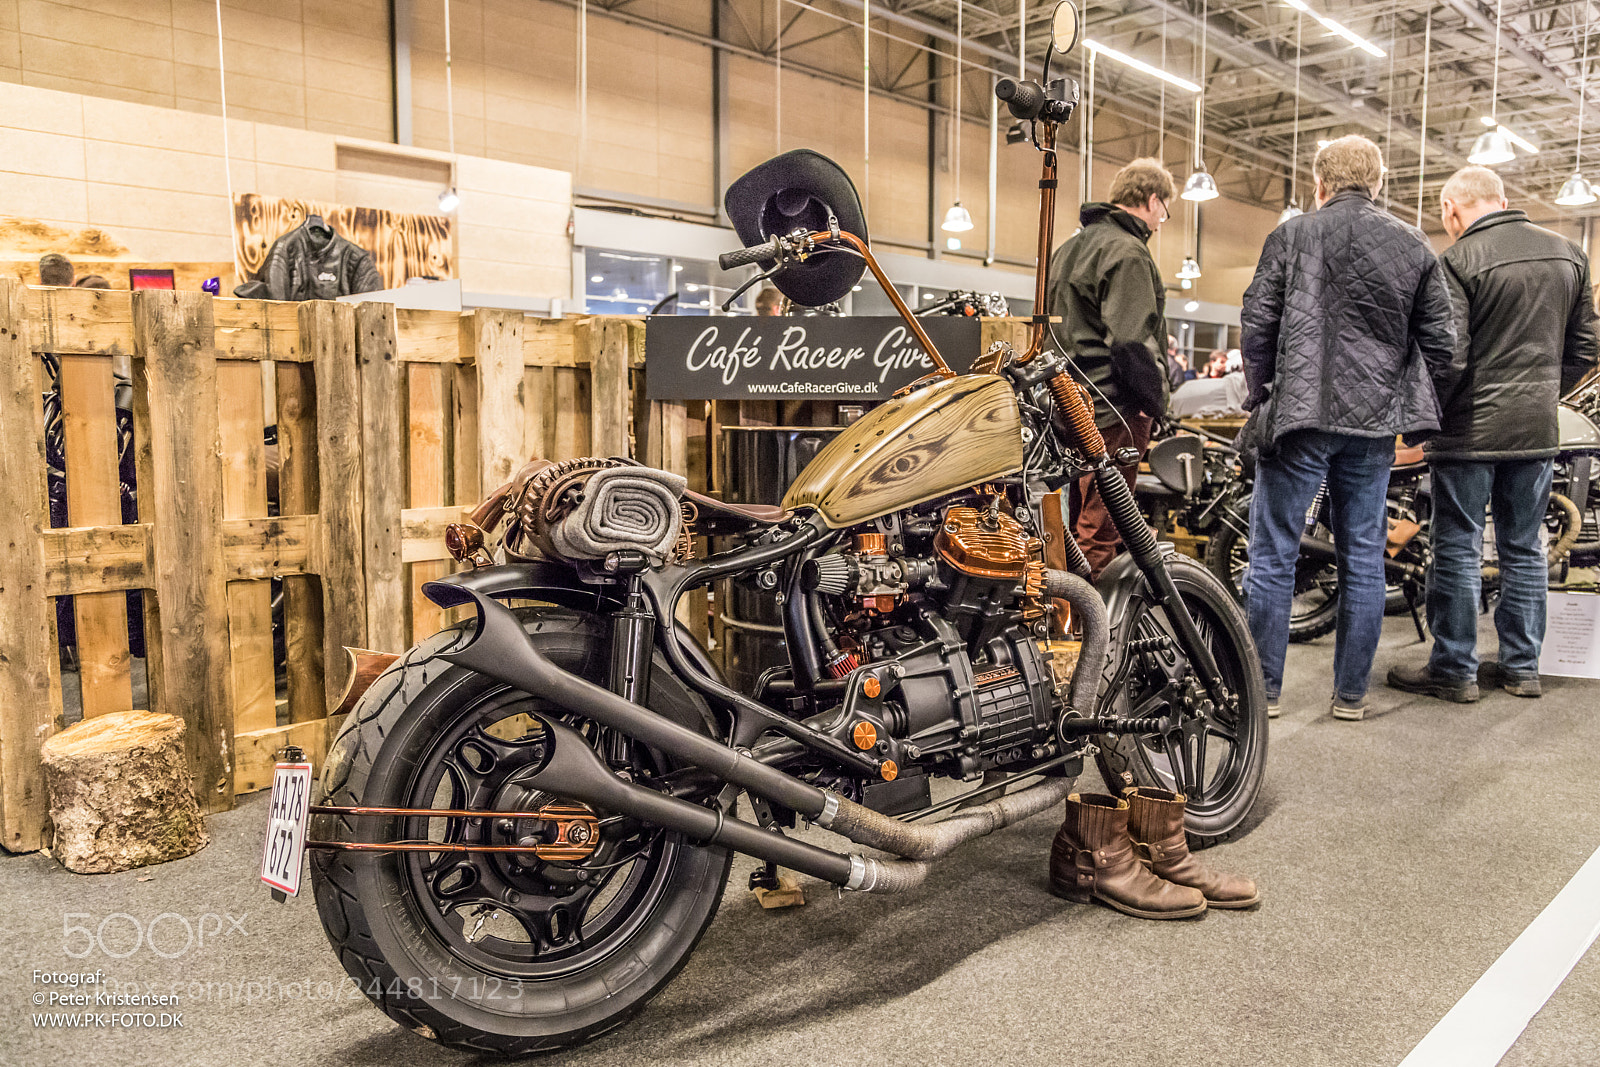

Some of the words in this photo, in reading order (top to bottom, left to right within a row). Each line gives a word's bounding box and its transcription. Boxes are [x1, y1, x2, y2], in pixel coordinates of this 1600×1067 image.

[686, 326, 762, 385] Café
[769, 325, 865, 371] Racer
[873, 326, 934, 383] Give
[748, 382, 879, 394] www.CafeRacerGive.dk
[271, 775, 304, 823] AA78
[269, 827, 293, 880] 672
